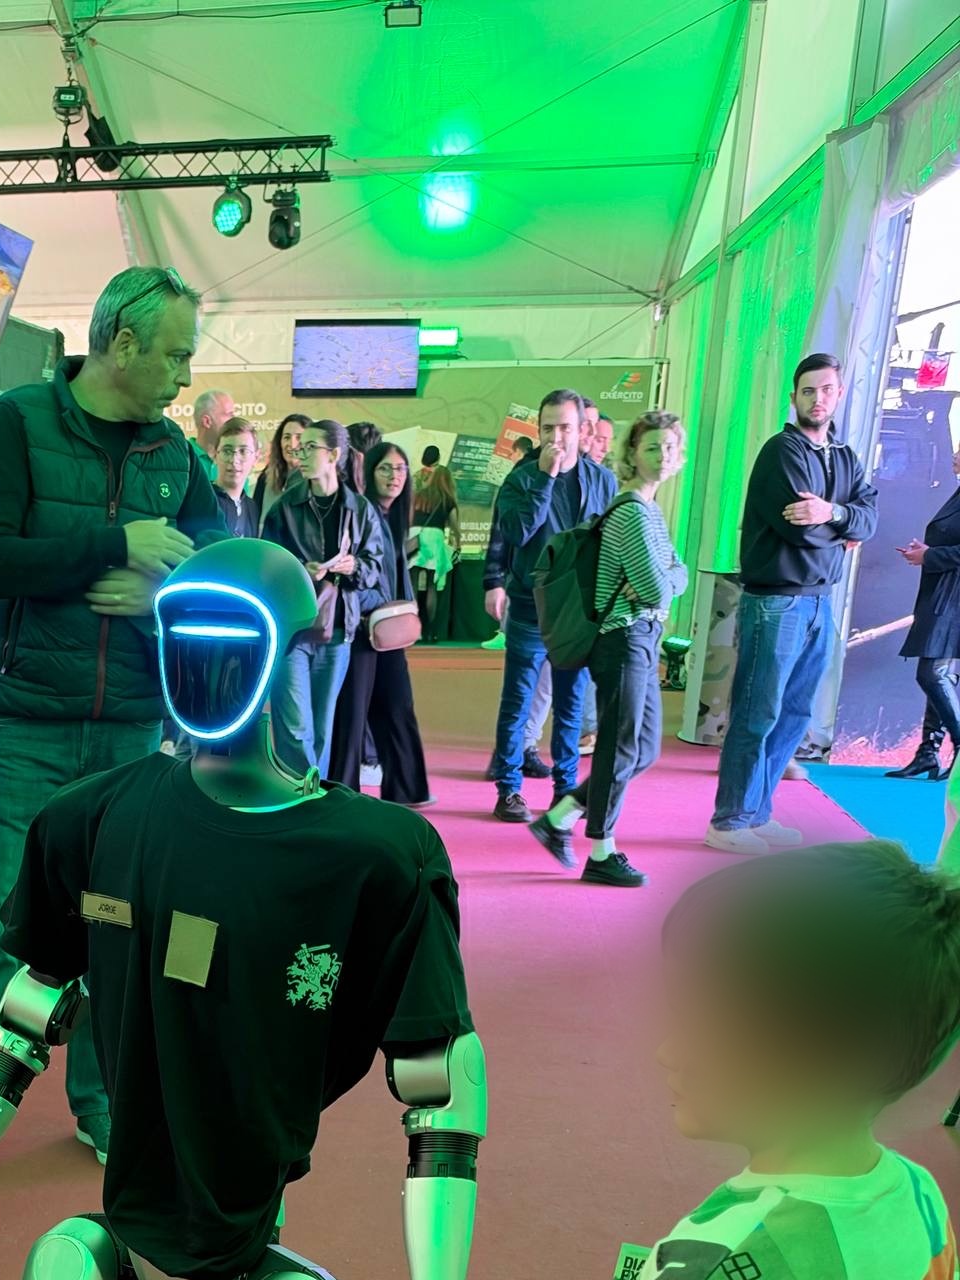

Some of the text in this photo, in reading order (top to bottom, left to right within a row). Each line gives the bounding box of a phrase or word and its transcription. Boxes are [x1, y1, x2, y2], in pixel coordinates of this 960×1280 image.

[599, 390, 644, 400] EXÉRCITO
[172, 403, 195, 416] DO
[233, 402, 267, 416] CITO
